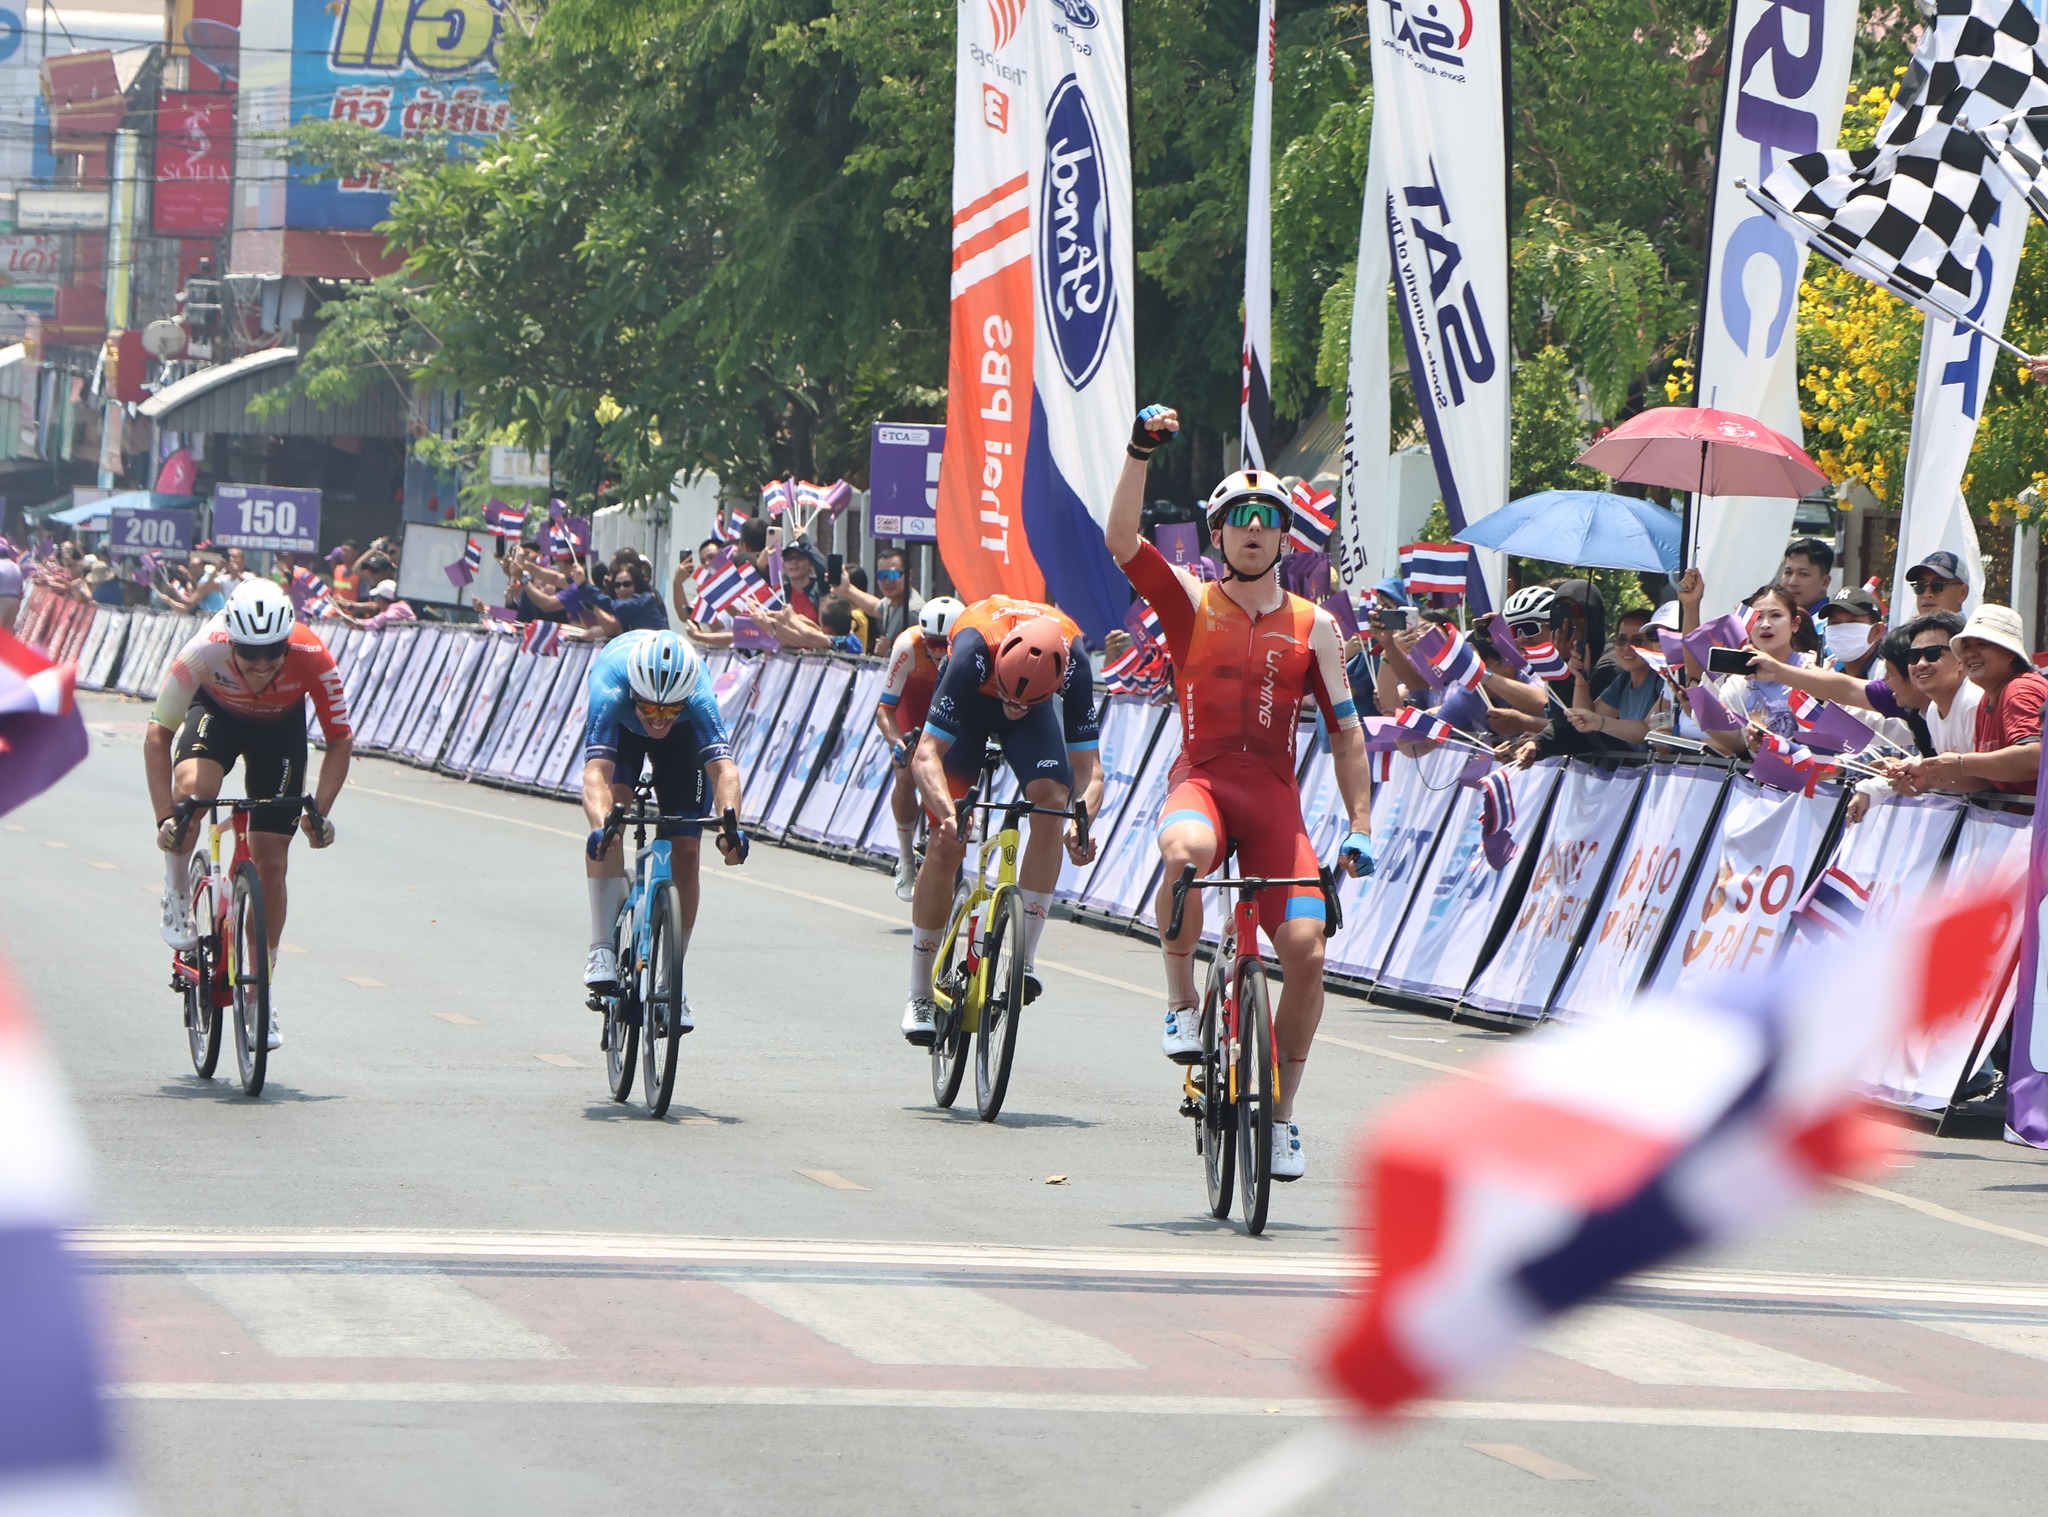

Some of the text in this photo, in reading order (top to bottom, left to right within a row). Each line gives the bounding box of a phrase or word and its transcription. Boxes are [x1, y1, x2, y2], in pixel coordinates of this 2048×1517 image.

[888, 431, 911, 442] TCA
[125, 517, 176, 546] 200
[237, 499, 297, 536] 150
[886, 650, 910, 690] LI-NING
[1258, 649, 1283, 729] LI-NING
[319, 665, 350, 725] ANTA
[1186, 682, 1195, 743] TREK
[929, 704, 961, 726] VANILLA
